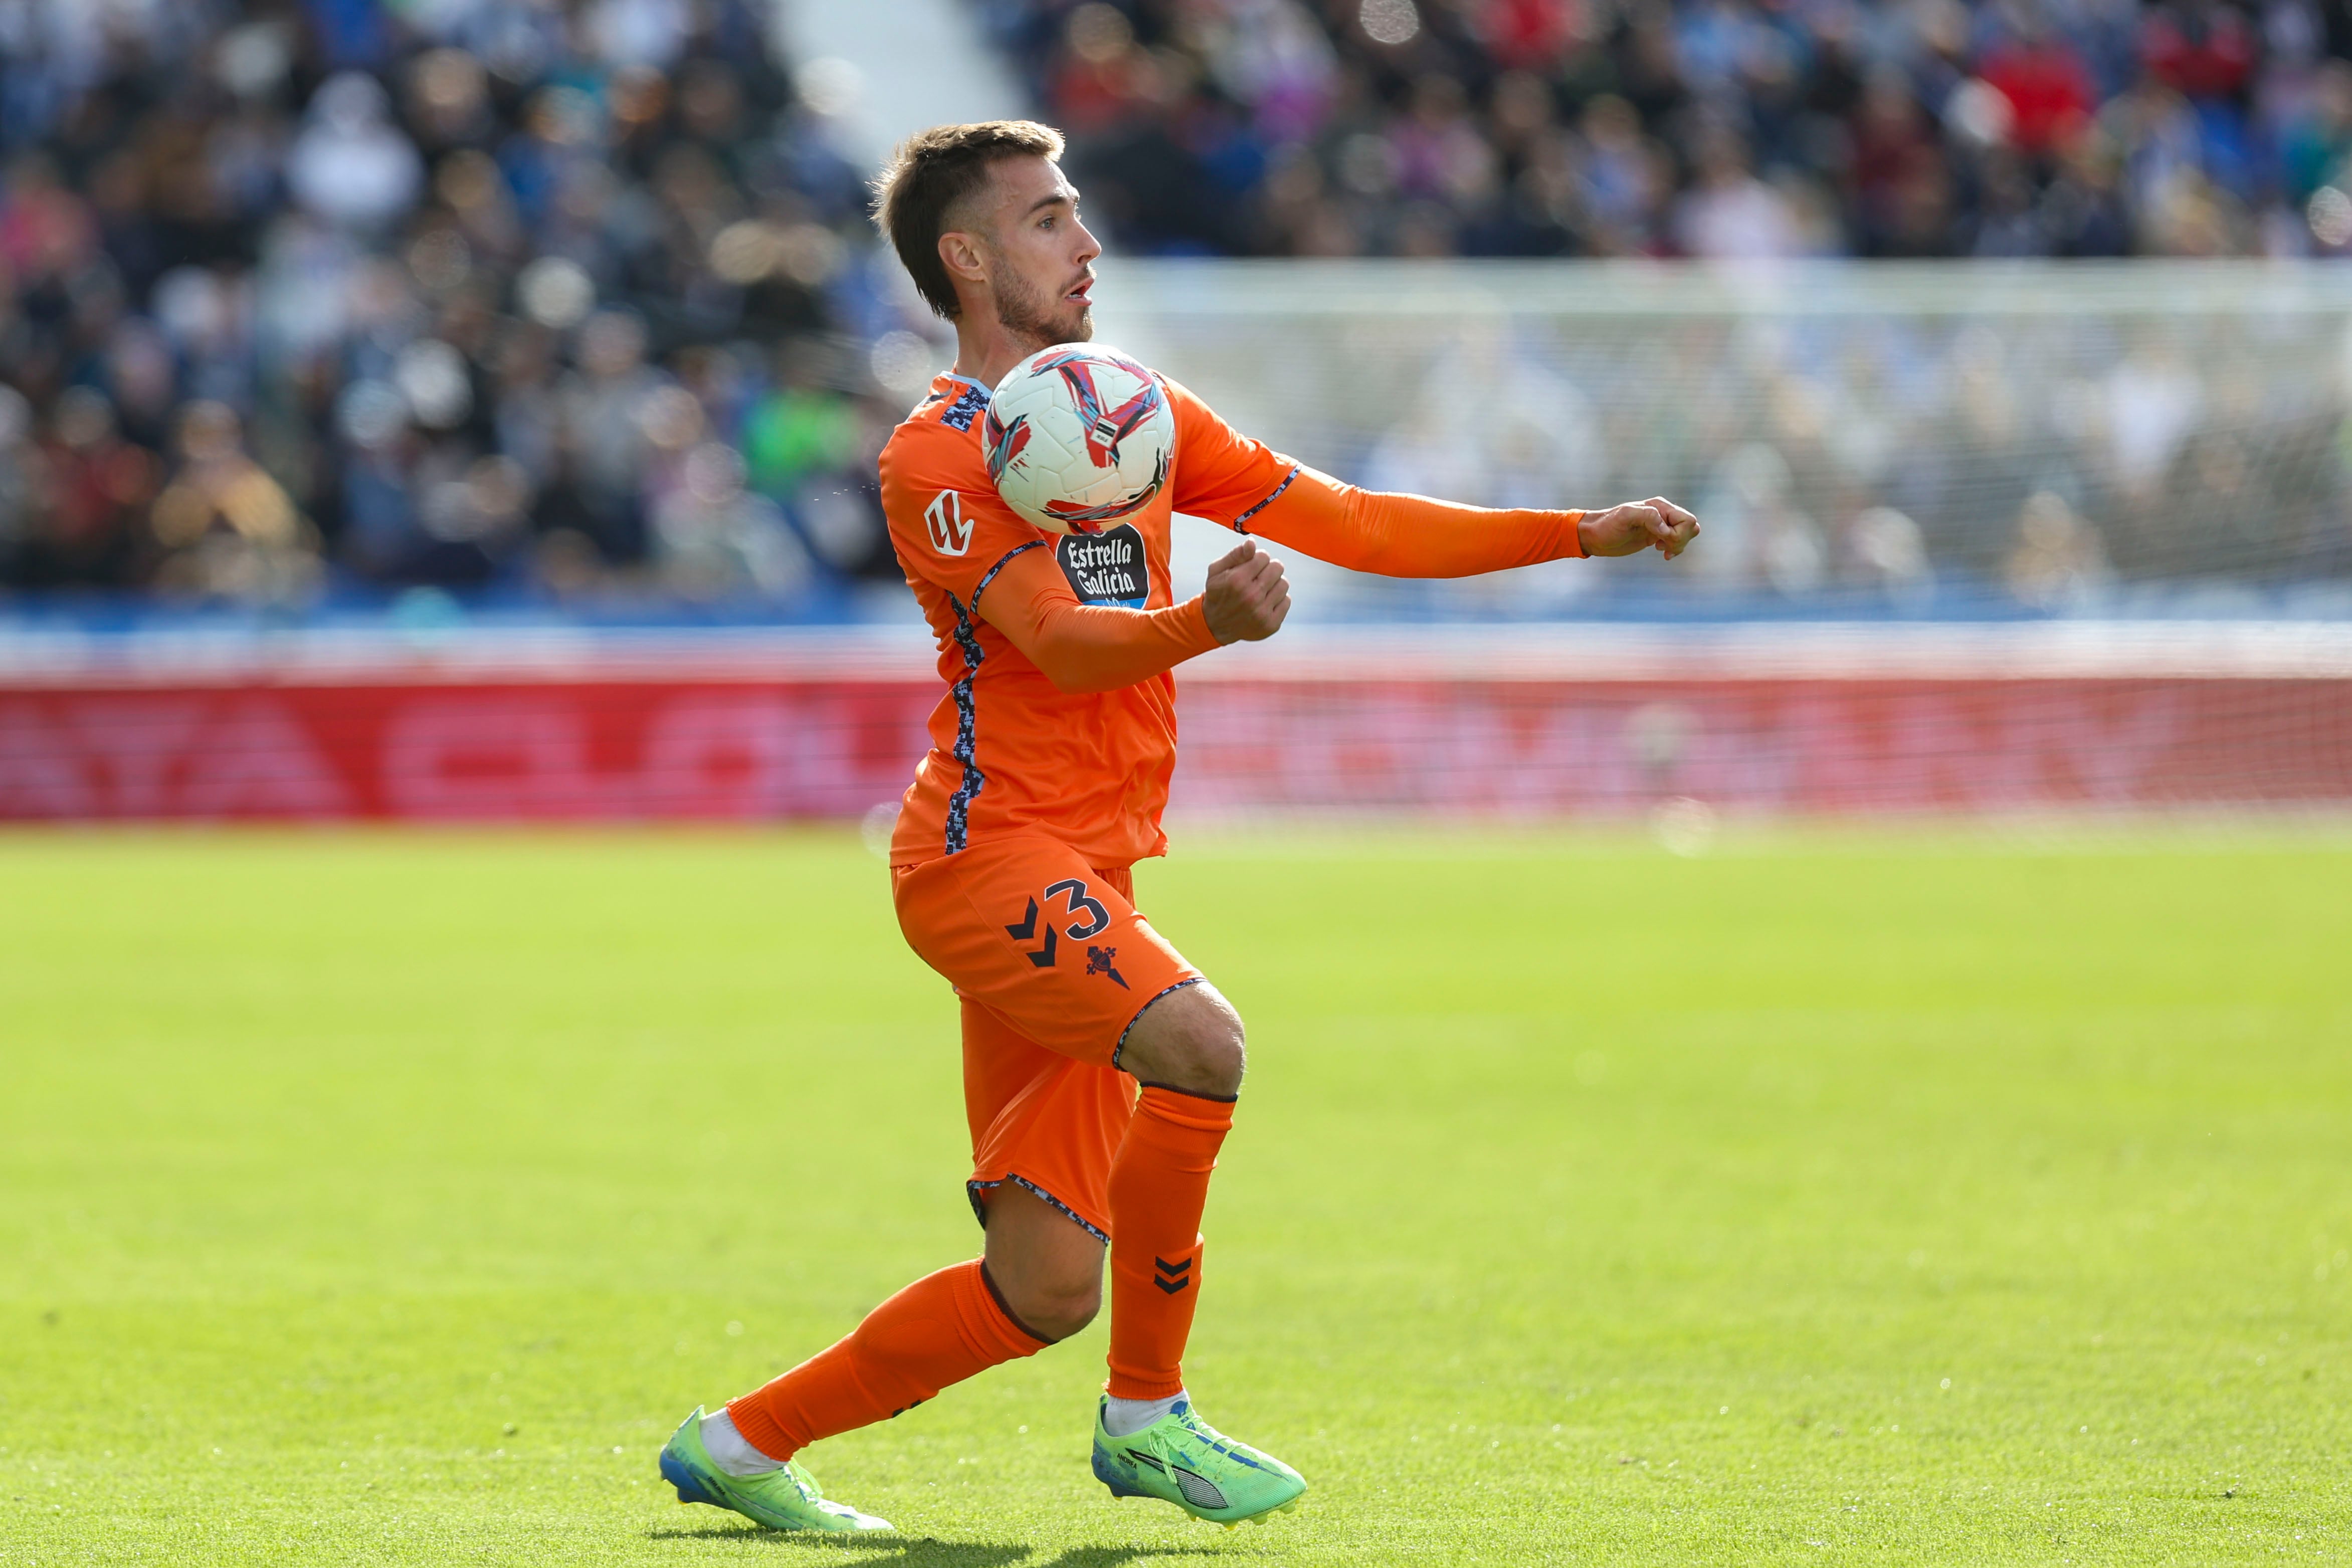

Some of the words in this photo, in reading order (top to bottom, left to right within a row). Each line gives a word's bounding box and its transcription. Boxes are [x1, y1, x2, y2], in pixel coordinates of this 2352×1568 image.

[1067, 538, 1132, 569] Estrella
[1077, 567, 1136, 595] Galicia
[1044, 878, 1111, 941] 3
[1117, 1453, 1137, 1470] ANDREA
